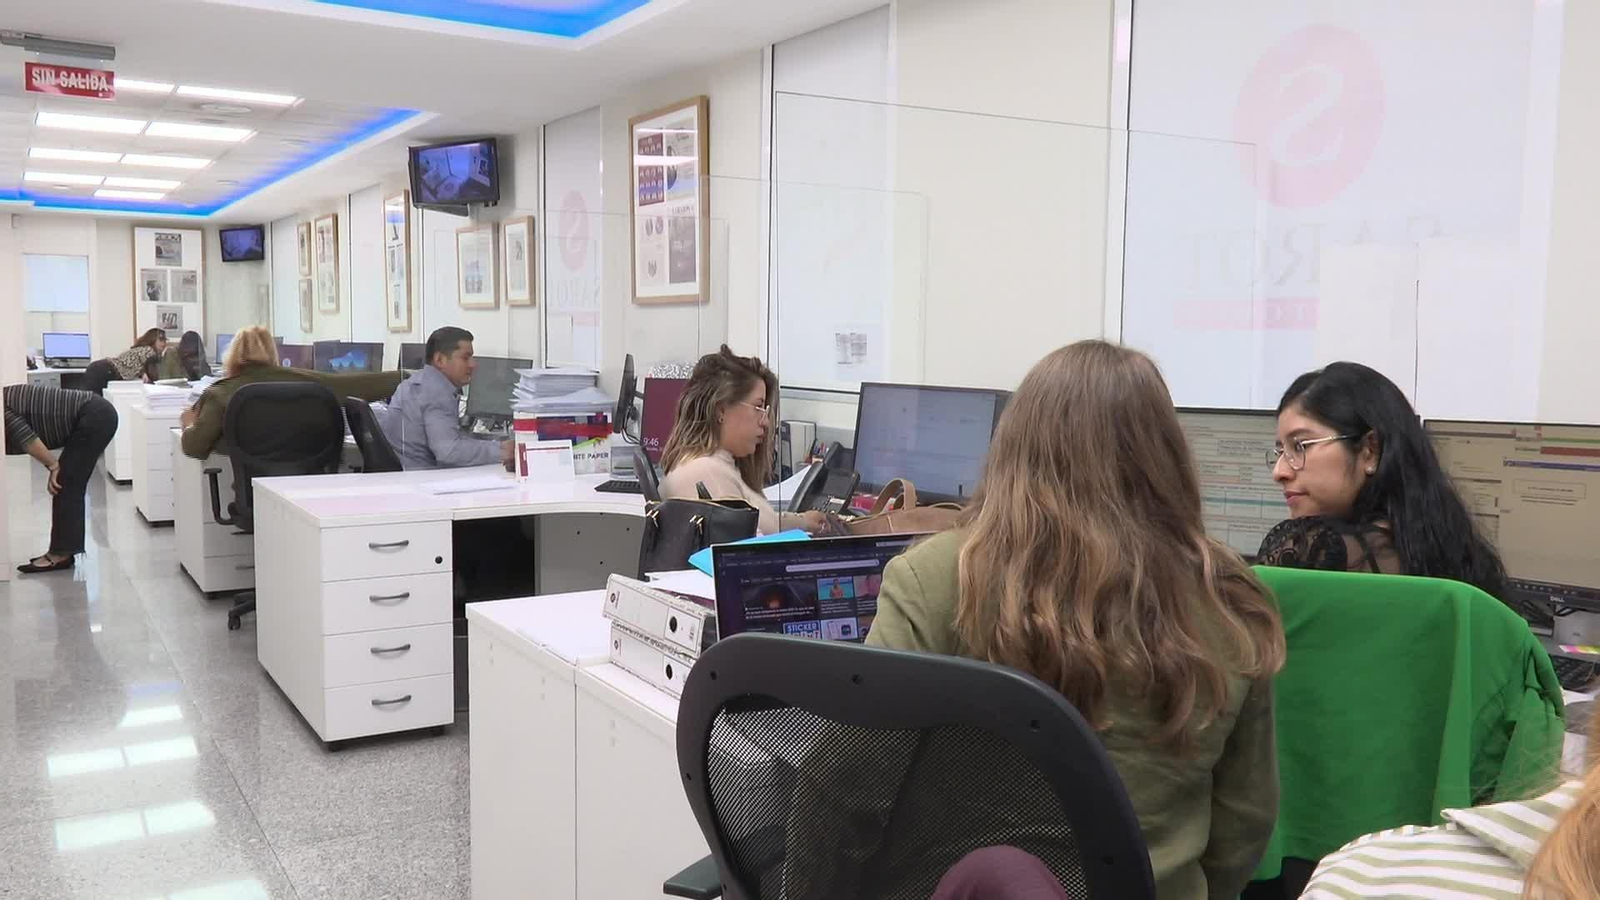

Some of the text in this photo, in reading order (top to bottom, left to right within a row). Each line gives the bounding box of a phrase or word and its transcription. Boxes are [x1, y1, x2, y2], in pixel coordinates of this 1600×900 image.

[32, 66, 108, 92] SIN SALIDA
[643, 437, 659, 447] 9:46
[587, 452, 609, 460] PAPER
[1550, 595, 1565, 603] DELL
[787, 623, 817, 632] STICKER
